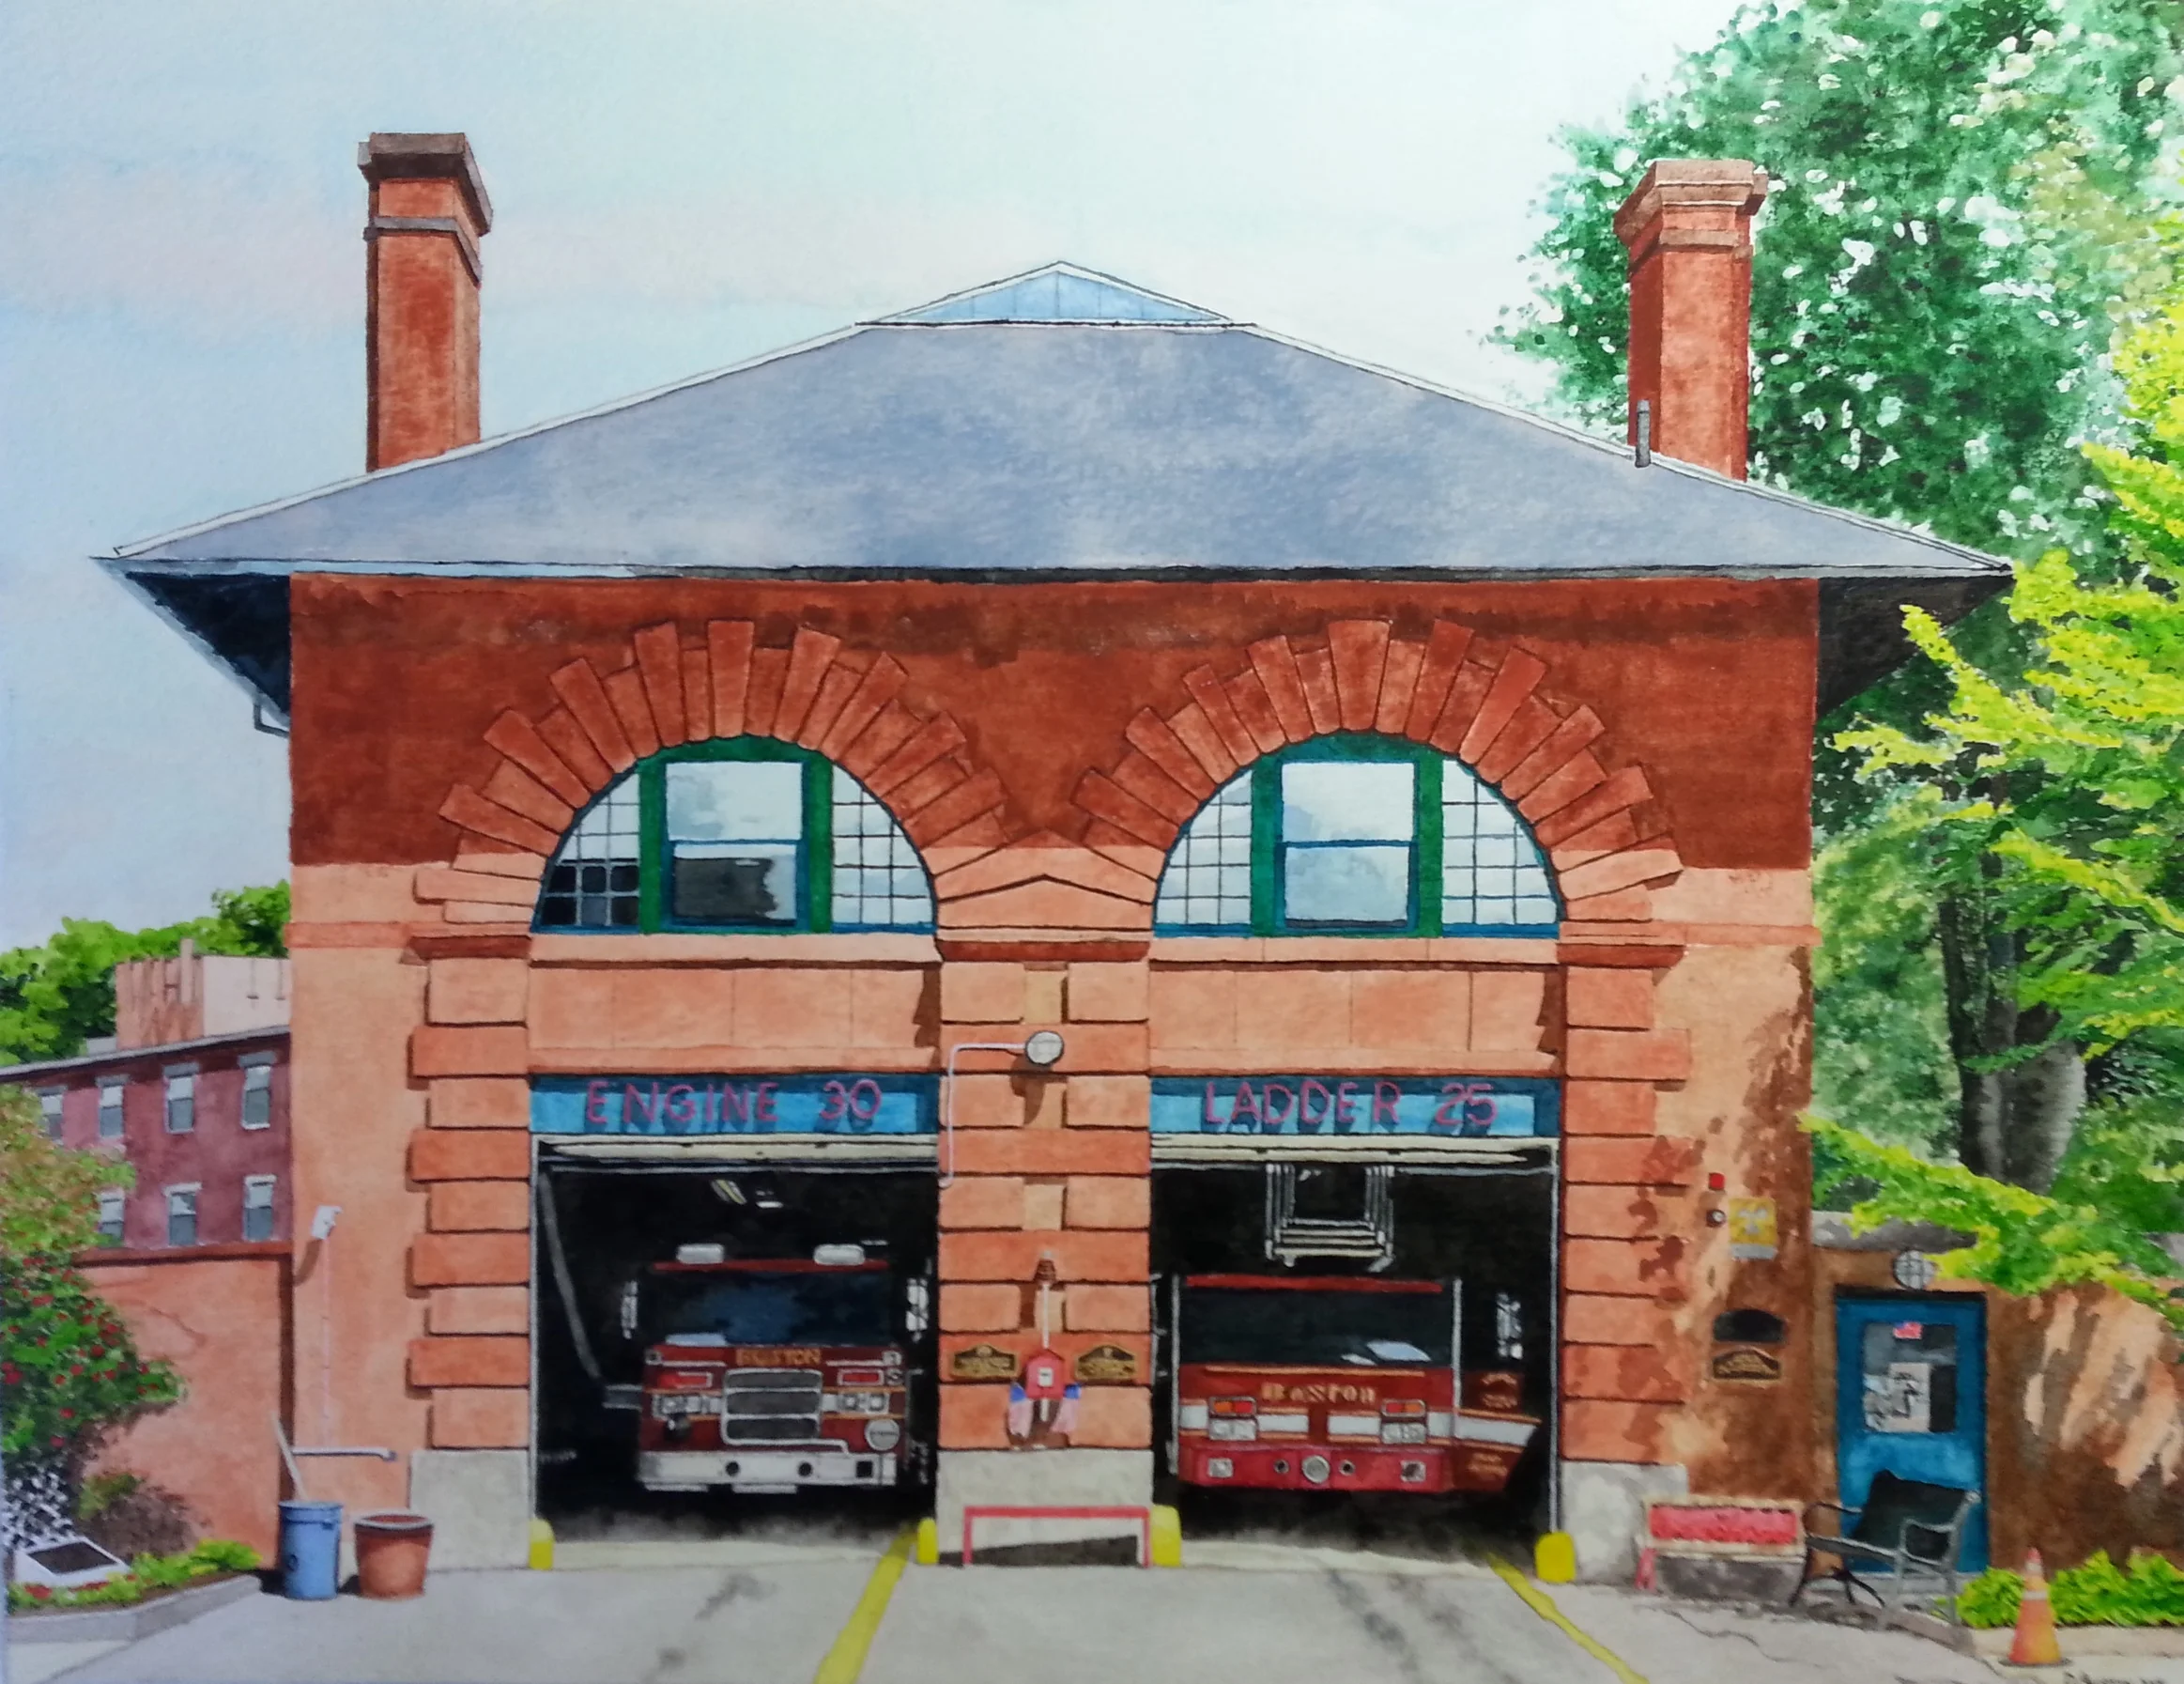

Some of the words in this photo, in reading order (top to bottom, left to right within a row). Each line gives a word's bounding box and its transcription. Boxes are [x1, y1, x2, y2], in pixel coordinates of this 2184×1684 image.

[587, 1080, 778, 1124] ENGINE
[819, 1079, 882, 1120] 30
[1204, 1080, 1400, 1125] LADDER
[1435, 1082, 1498, 1126] 25
